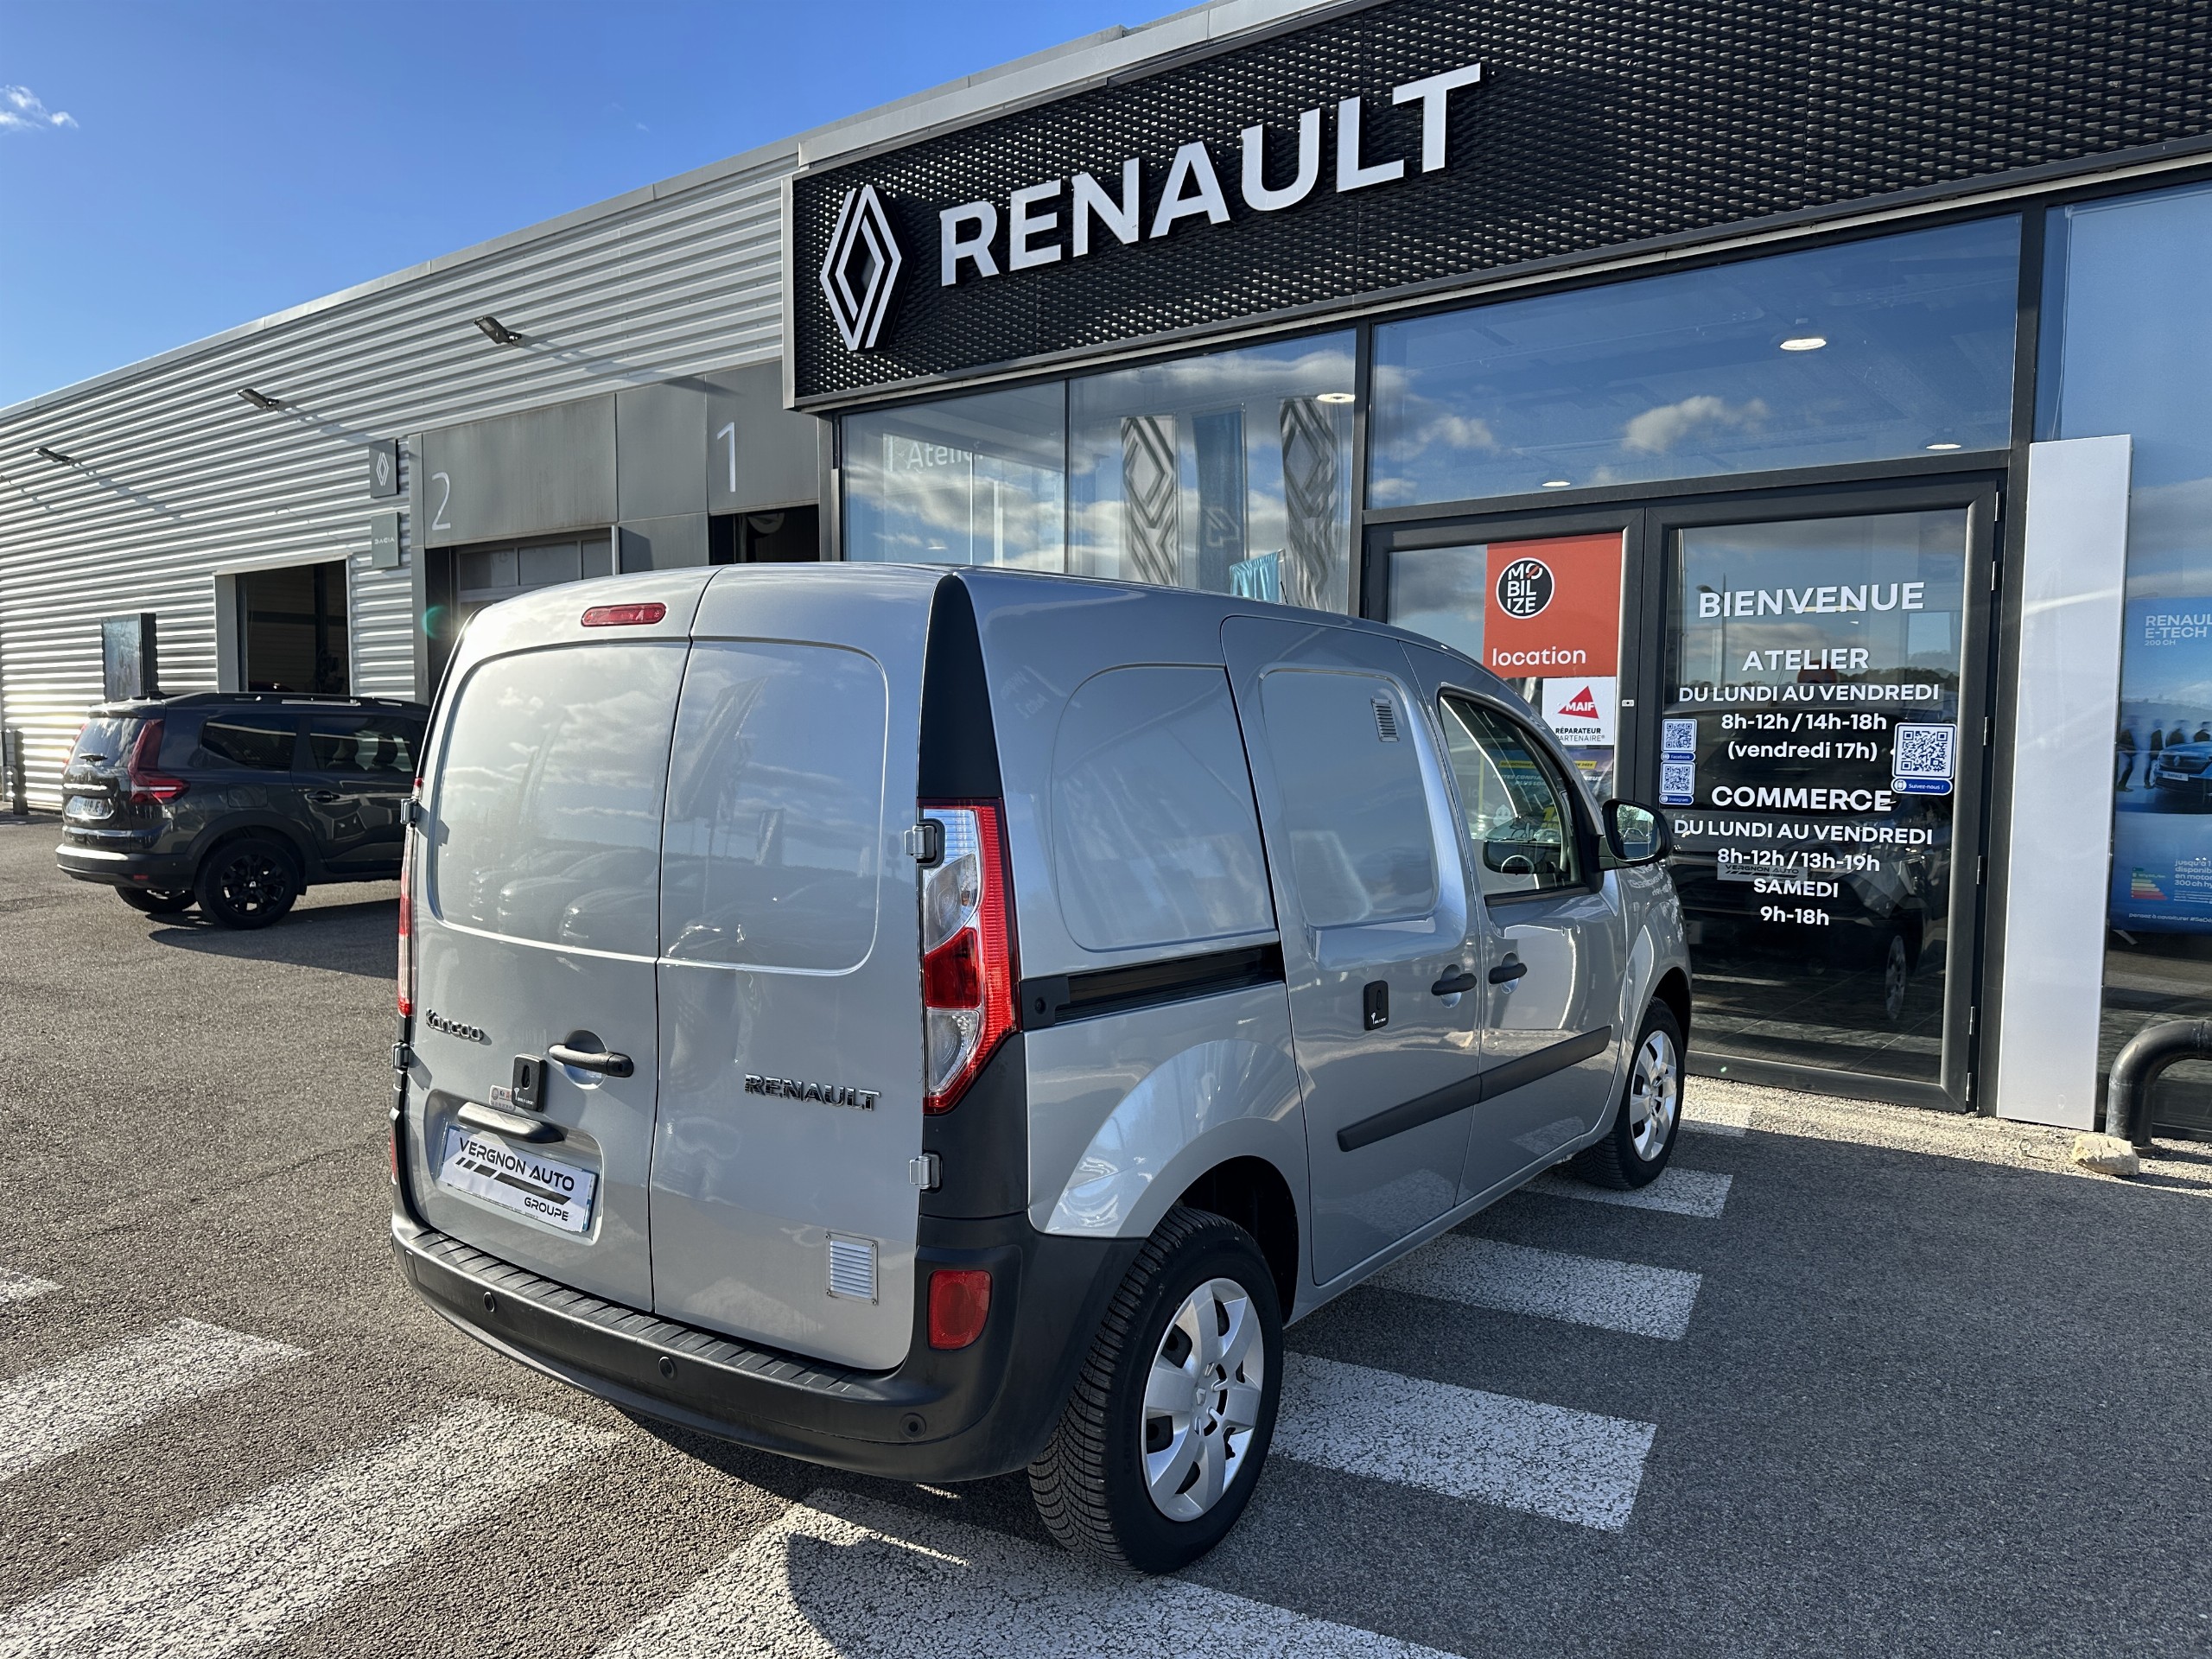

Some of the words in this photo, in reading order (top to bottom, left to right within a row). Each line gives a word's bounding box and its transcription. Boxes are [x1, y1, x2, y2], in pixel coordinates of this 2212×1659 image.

[940, 63, 1482, 286] RENAULT
[716, 422, 736, 493] 1
[432, 472, 451, 531] 2
[1699, 582, 1925, 618] BIENVENUE
[2145, 626, 2207, 639] E-TECH
[1492, 646, 1586, 666] location
[1741, 648, 1870, 671] ATELIER
[1679, 687, 1708, 702] DU
[1713, 686, 1778, 702] LUNDI
[1782, 685, 1815, 702] AU
[1818, 683, 1939, 701] VENDREDI
[1565, 702, 1595, 712] MAIF
[1555, 726, 1601, 734] RÉPARATEUR
[1728, 741, 1831, 760] (vendredi
[1835, 741, 1878, 762] 17h)
[1711, 786, 1892, 811] COMMERCE
[1674, 820, 1704, 836] DU
[1707, 821, 1773, 838] LUNDI
[1777, 823, 1809, 840] AU
[1814, 825, 1933, 845] VENDREDI
[1725, 864, 1770, 873] VERGNON
[1753, 878, 1839, 898] SAMEDI
[1760, 906, 1829, 925] 9h-18h
[744, 1073, 882, 1111] RENAULT
[459, 1137, 526, 1175] VERGNON
[529, 1165, 575, 1192] AUTO
[524, 1197, 569, 1222] GROUPE
